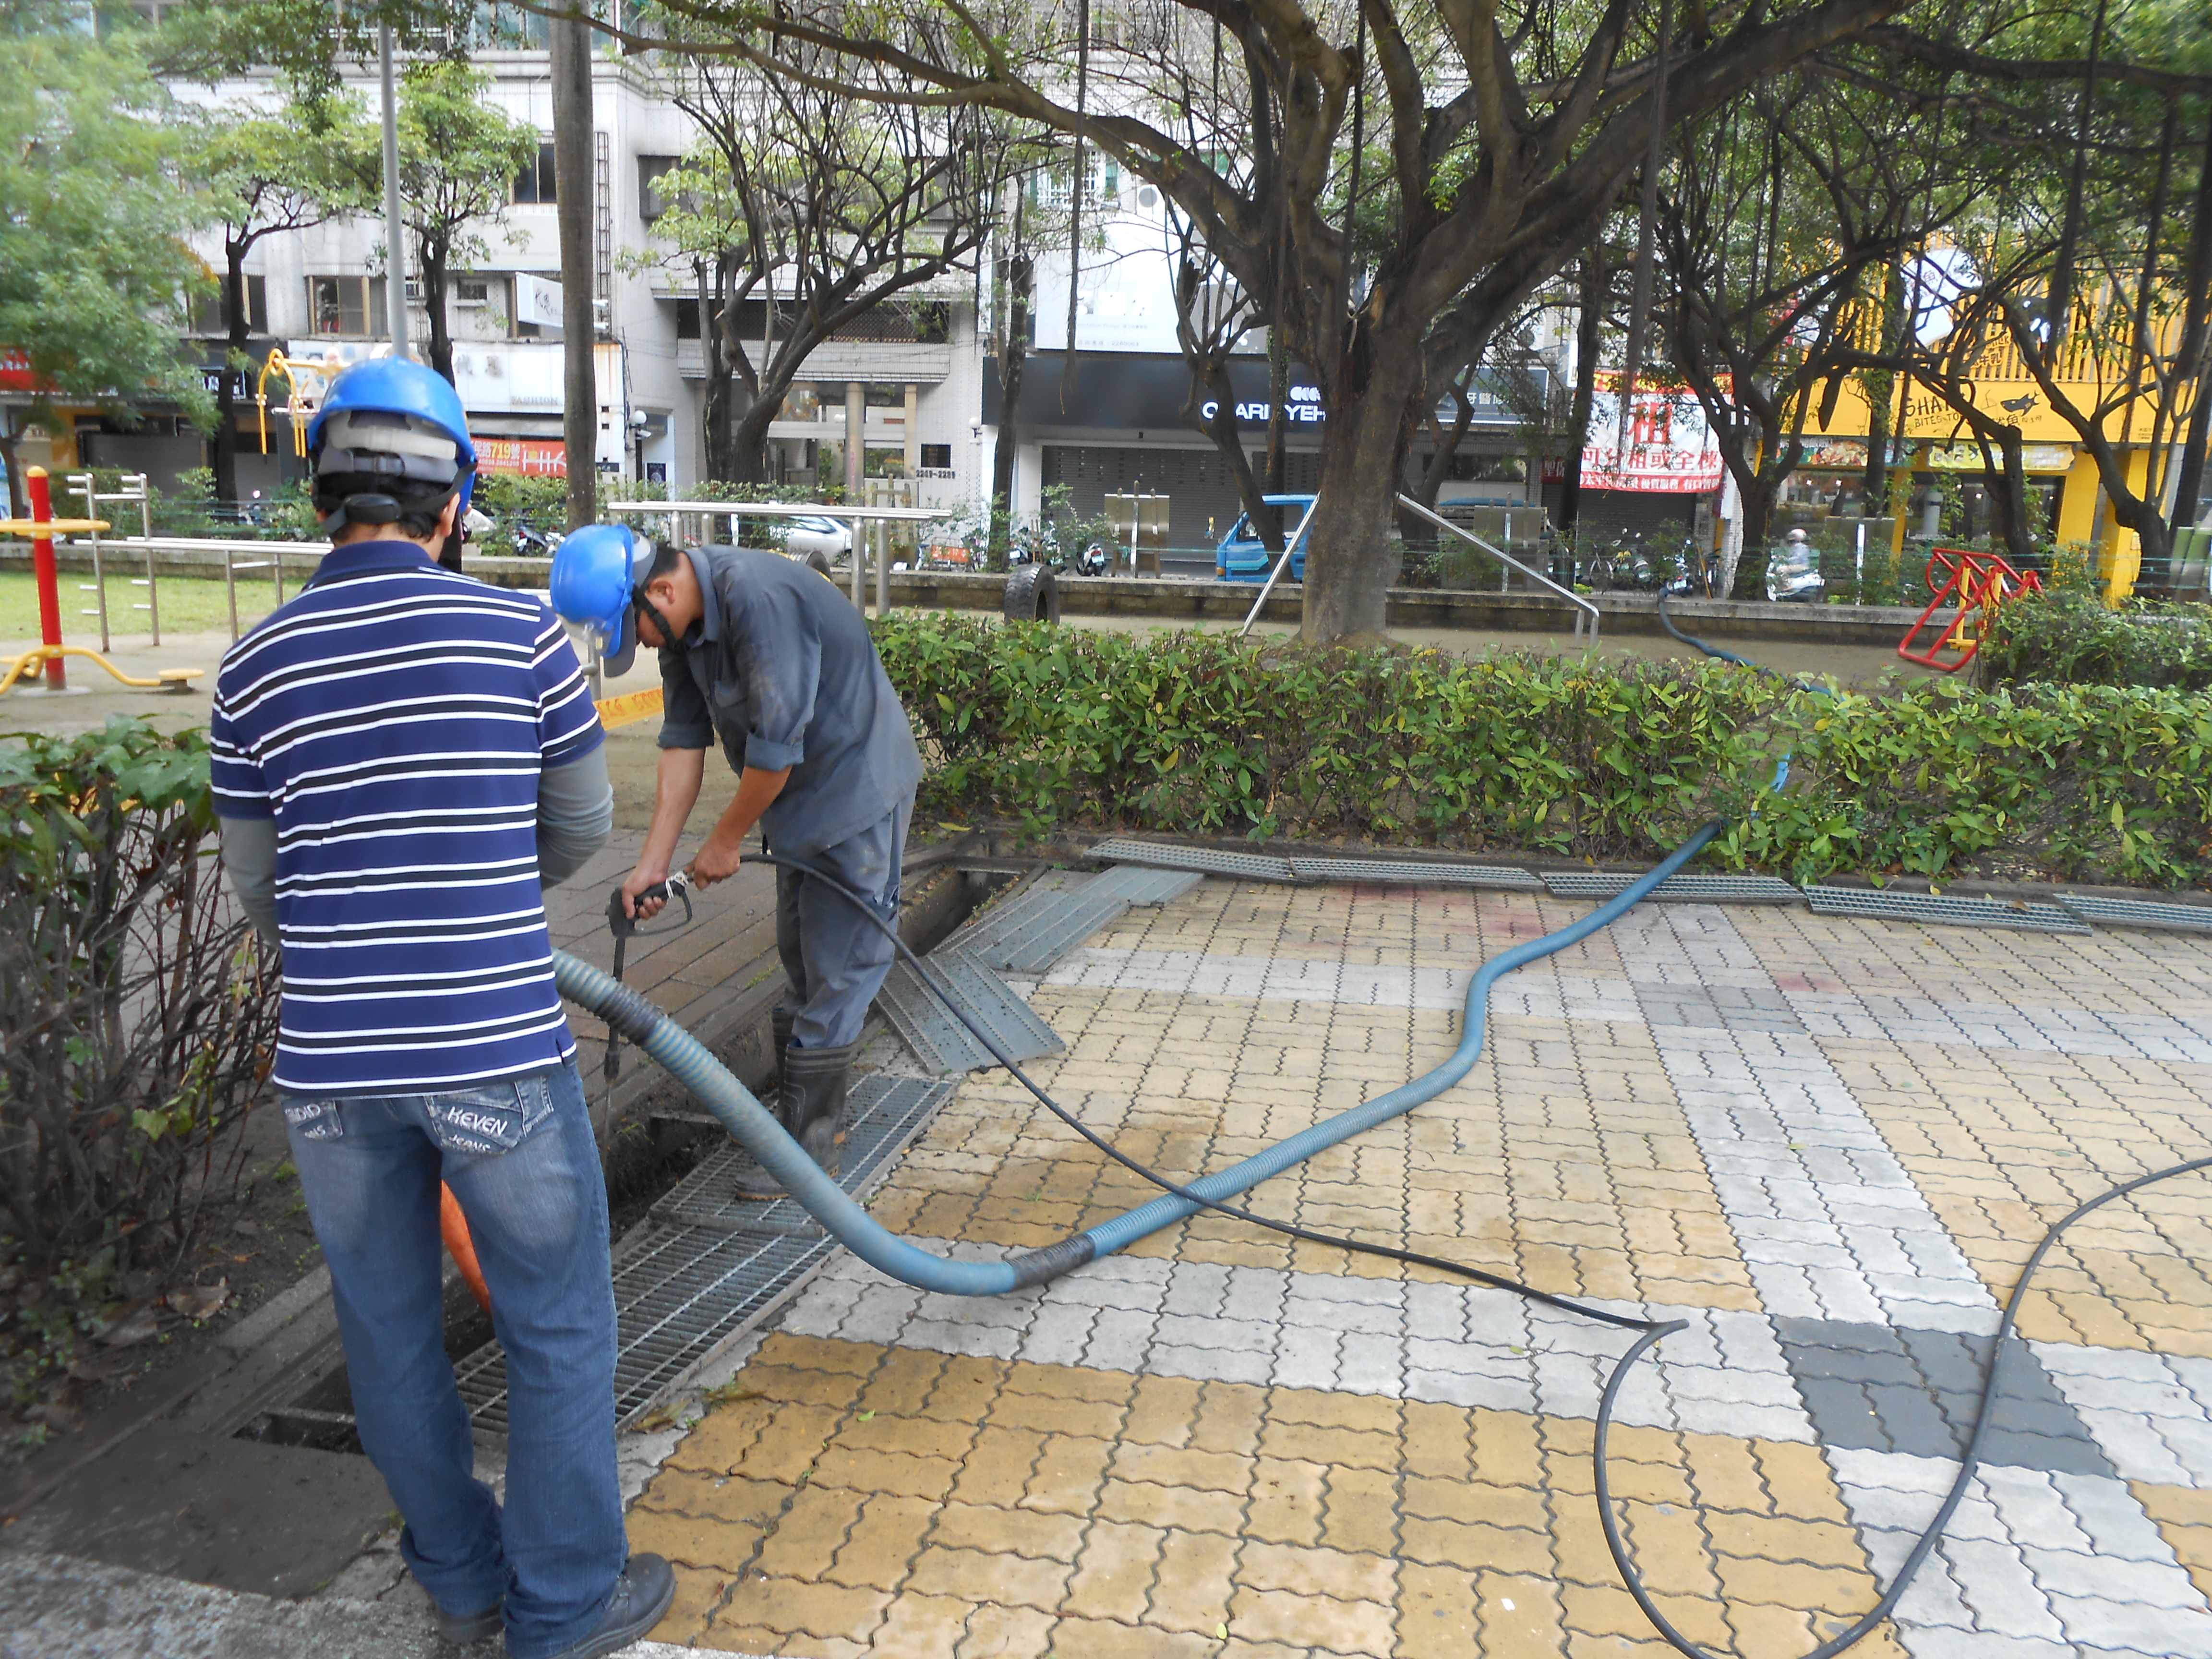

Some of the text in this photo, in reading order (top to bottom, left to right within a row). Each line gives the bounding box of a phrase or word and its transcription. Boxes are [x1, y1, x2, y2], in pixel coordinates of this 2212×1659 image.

[1628, 400, 1674, 445] 租
[1915, 415, 1943, 428] BITES
[1582, 447, 1720, 471] 可分租或全棟
[447, 1106, 508, 1136] KEVEN
